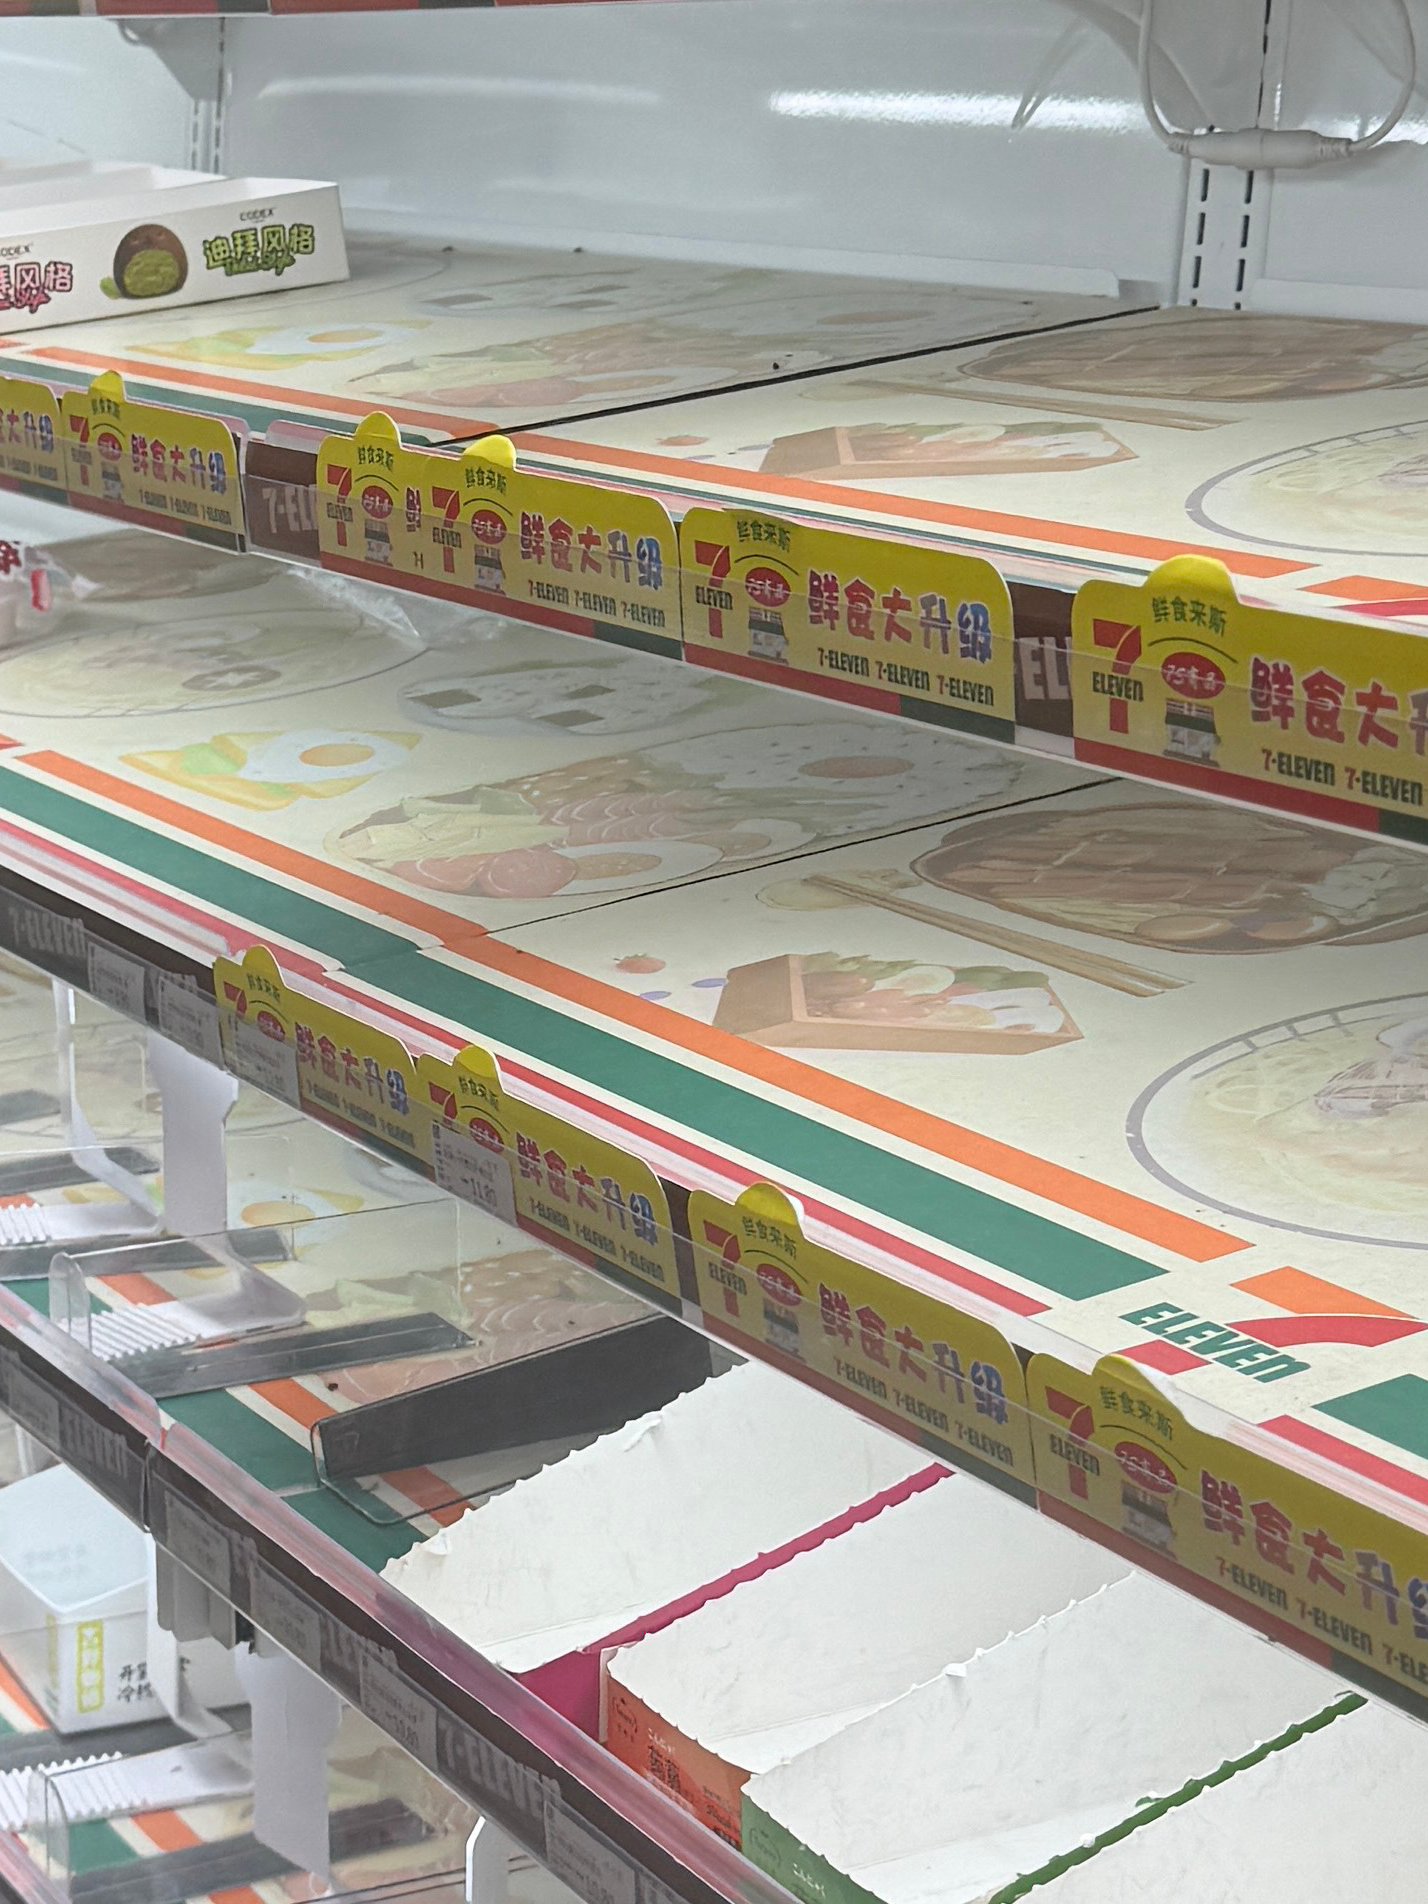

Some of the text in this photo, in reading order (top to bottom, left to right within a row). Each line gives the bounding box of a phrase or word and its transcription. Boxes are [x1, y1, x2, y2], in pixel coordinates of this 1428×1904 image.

[202, 224, 315, 270] 迪拜风格
[131, 419, 229, 495] 鲜食大升级
[465, 467, 507, 495] 鲜食来斯
[327, 464, 351, 548] 7
[432, 485, 460, 575] 7
[737, 520, 791, 553] 鲜食来斯
[520, 510, 662, 592] 鲜食大升级
[694, 541, 730, 639] 7
[808, 570, 993, 666] 鲜食大升级
[1152, 596, 1228, 637] 鲜食来斯
[1093, 619, 1142, 734] 7
[296, 1022, 411, 1117] 鲜食大升级
[516, 1132, 660, 1246] 鲜食大升级
[703, 1219, 738, 1315] 7
[742, 1214, 798, 1261] 鲜食来斯
[819, 1282, 1009, 1426] 鲜食大升级
[1047, 1386, 1092, 1500] 7
[1099, 1386, 1176, 1441] 鲜食来斯
